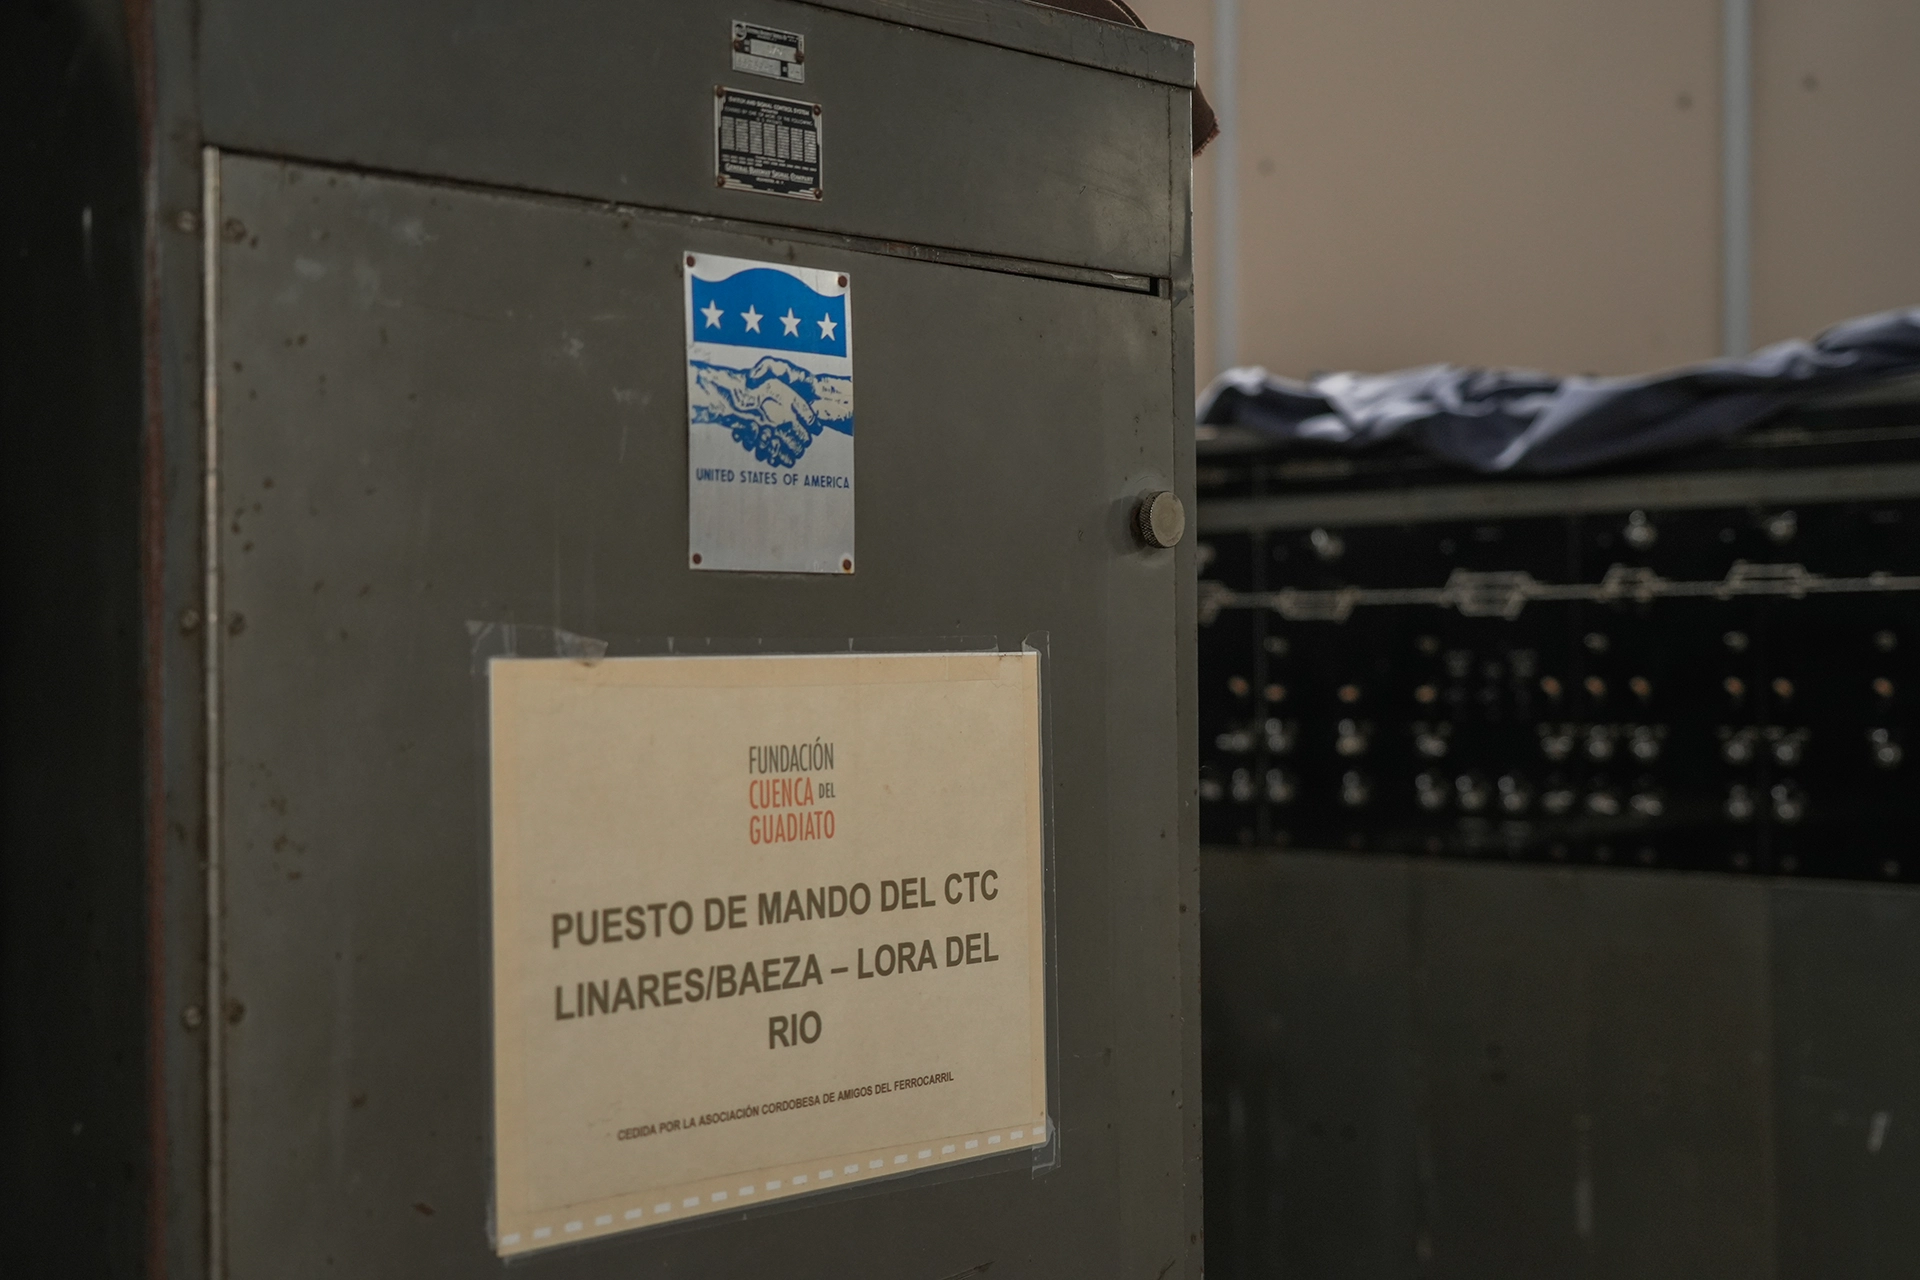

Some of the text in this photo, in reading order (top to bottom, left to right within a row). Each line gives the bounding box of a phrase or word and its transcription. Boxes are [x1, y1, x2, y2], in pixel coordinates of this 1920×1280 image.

[696, 467, 850, 489] UNITED STATES OF AMERICA
[748, 737, 835, 775] FUNDACIÓN
[748, 777, 836, 809] CUENCA DEL
[748, 810, 837, 845] GUADIATO
[552, 869, 999, 949] PUESTO DE MANDO DEL CTC
[555, 953, 823, 1021] LINARES/BAEZA
[857, 939, 938, 980] LORA
[946, 932, 999, 967] DEL
[768, 1010, 823, 1050] RIO
[617, 1071, 954, 1141] CEDIDA POR LA ASOCIACIÓN CORDOBESA DE AMIGOS DEL FERROCARRIL
